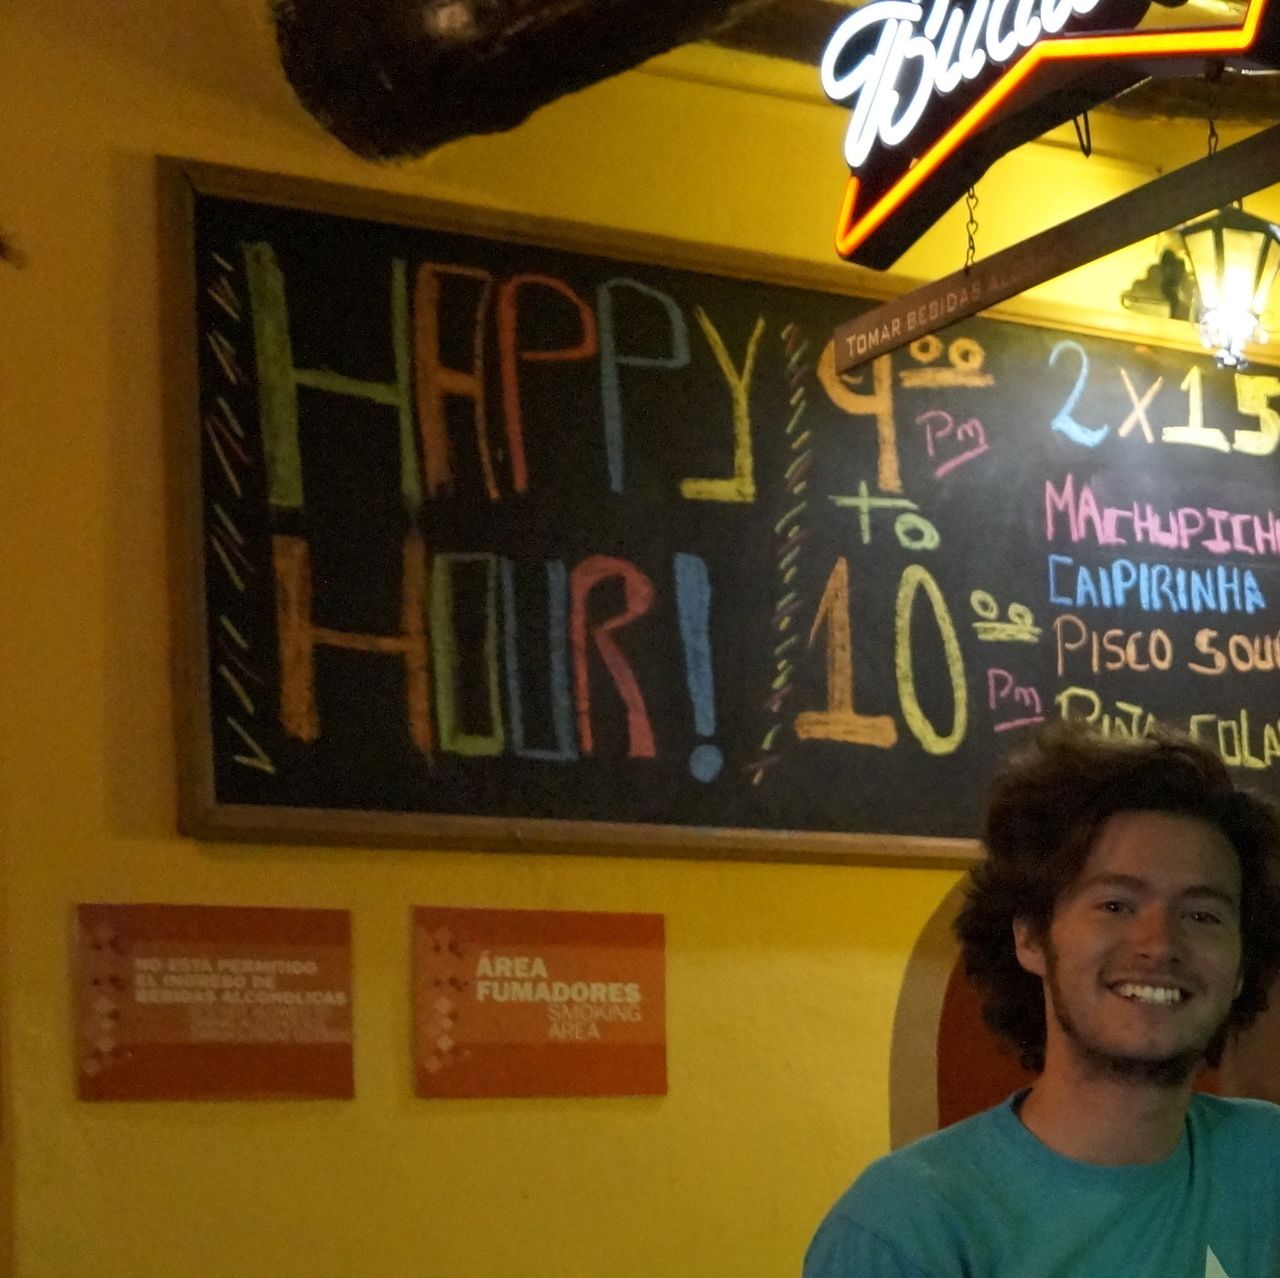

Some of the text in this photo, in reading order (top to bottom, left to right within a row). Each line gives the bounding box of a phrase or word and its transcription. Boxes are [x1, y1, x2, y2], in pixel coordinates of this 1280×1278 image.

[846, 281, 982, 357] TOMAR BEBIDAS
[244, 242, 766, 506] HAPPY
[1047, 554, 1266, 613] CAIPIRINHA
[271, 527, 724, 783] HOUR!
[1053, 614, 1172, 676] PISCO
[476, 950, 548, 978] ÁREA
[476, 981, 641, 1003] FUMADORES
[548, 1004, 642, 1022] SMOKING
[548, 1022, 600, 1040] AREA
